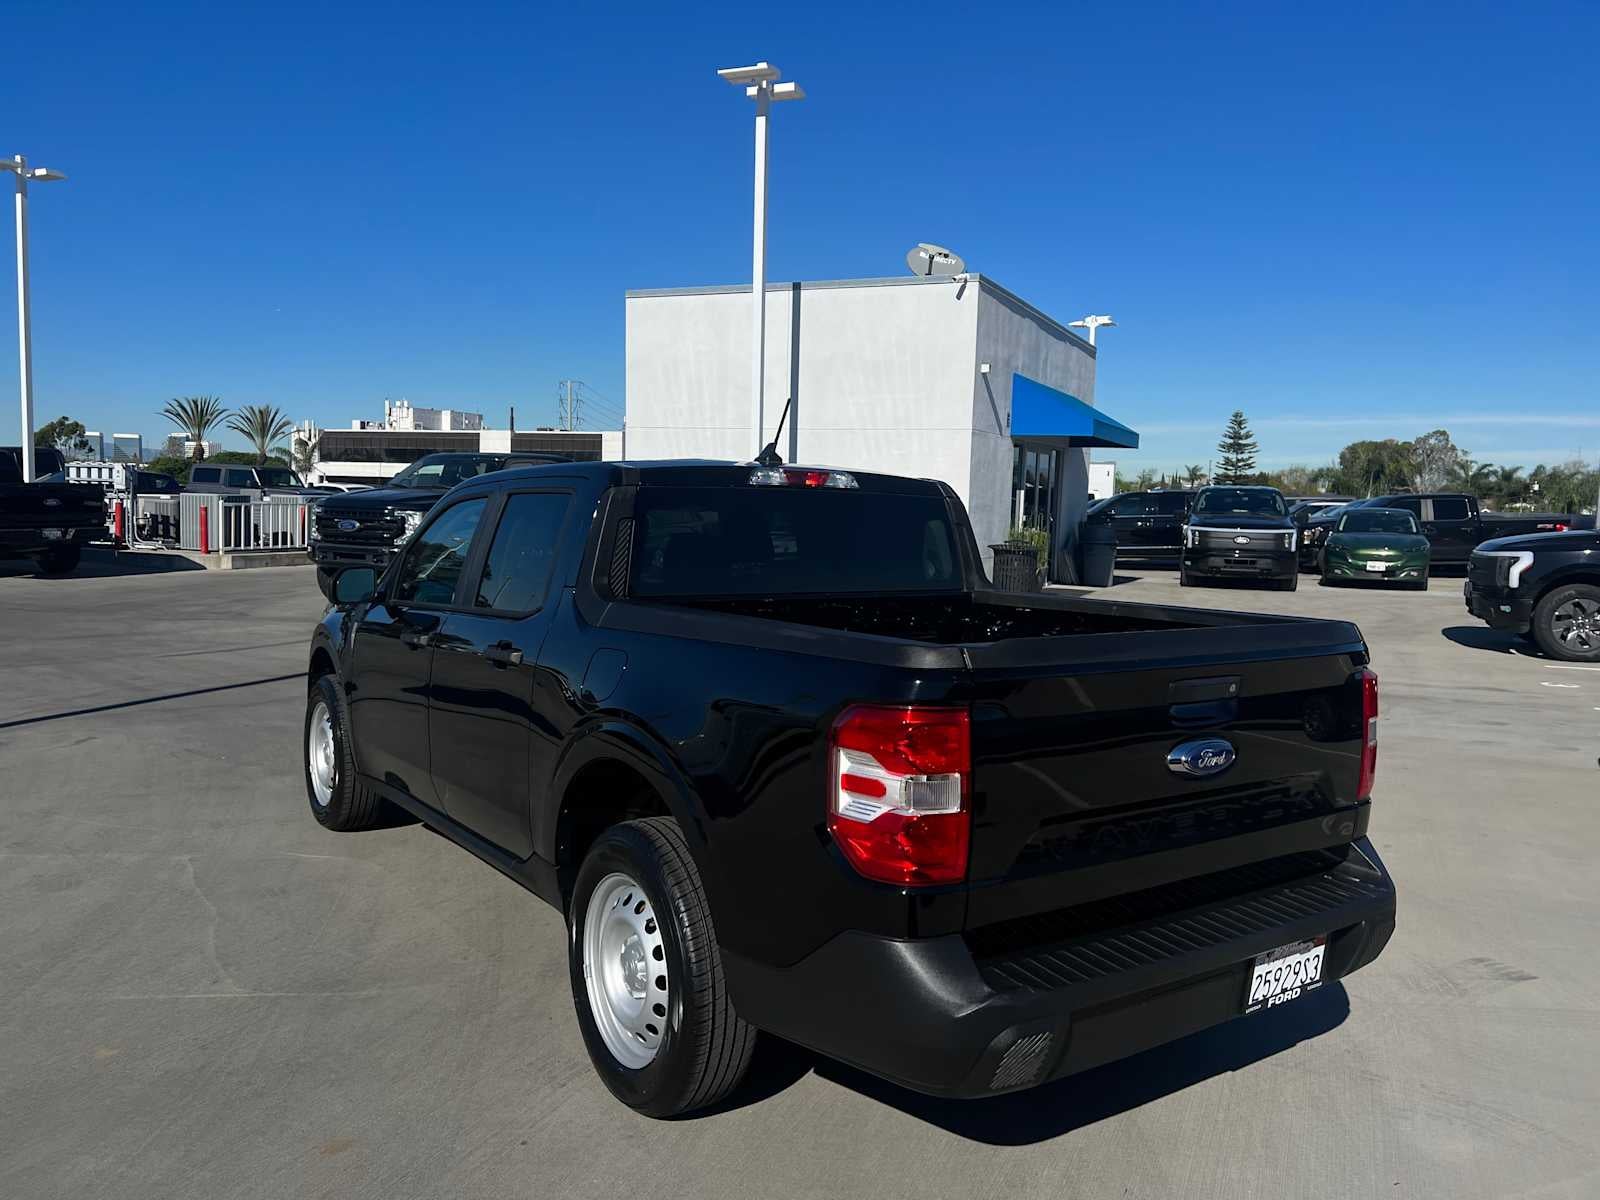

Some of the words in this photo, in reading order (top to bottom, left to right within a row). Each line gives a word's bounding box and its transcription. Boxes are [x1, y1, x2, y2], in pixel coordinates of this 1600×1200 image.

[1199, 748, 1226, 768] Ford
[1251, 954, 1320, 1002] 25929S3
[1267, 987, 1301, 1008] FORD
